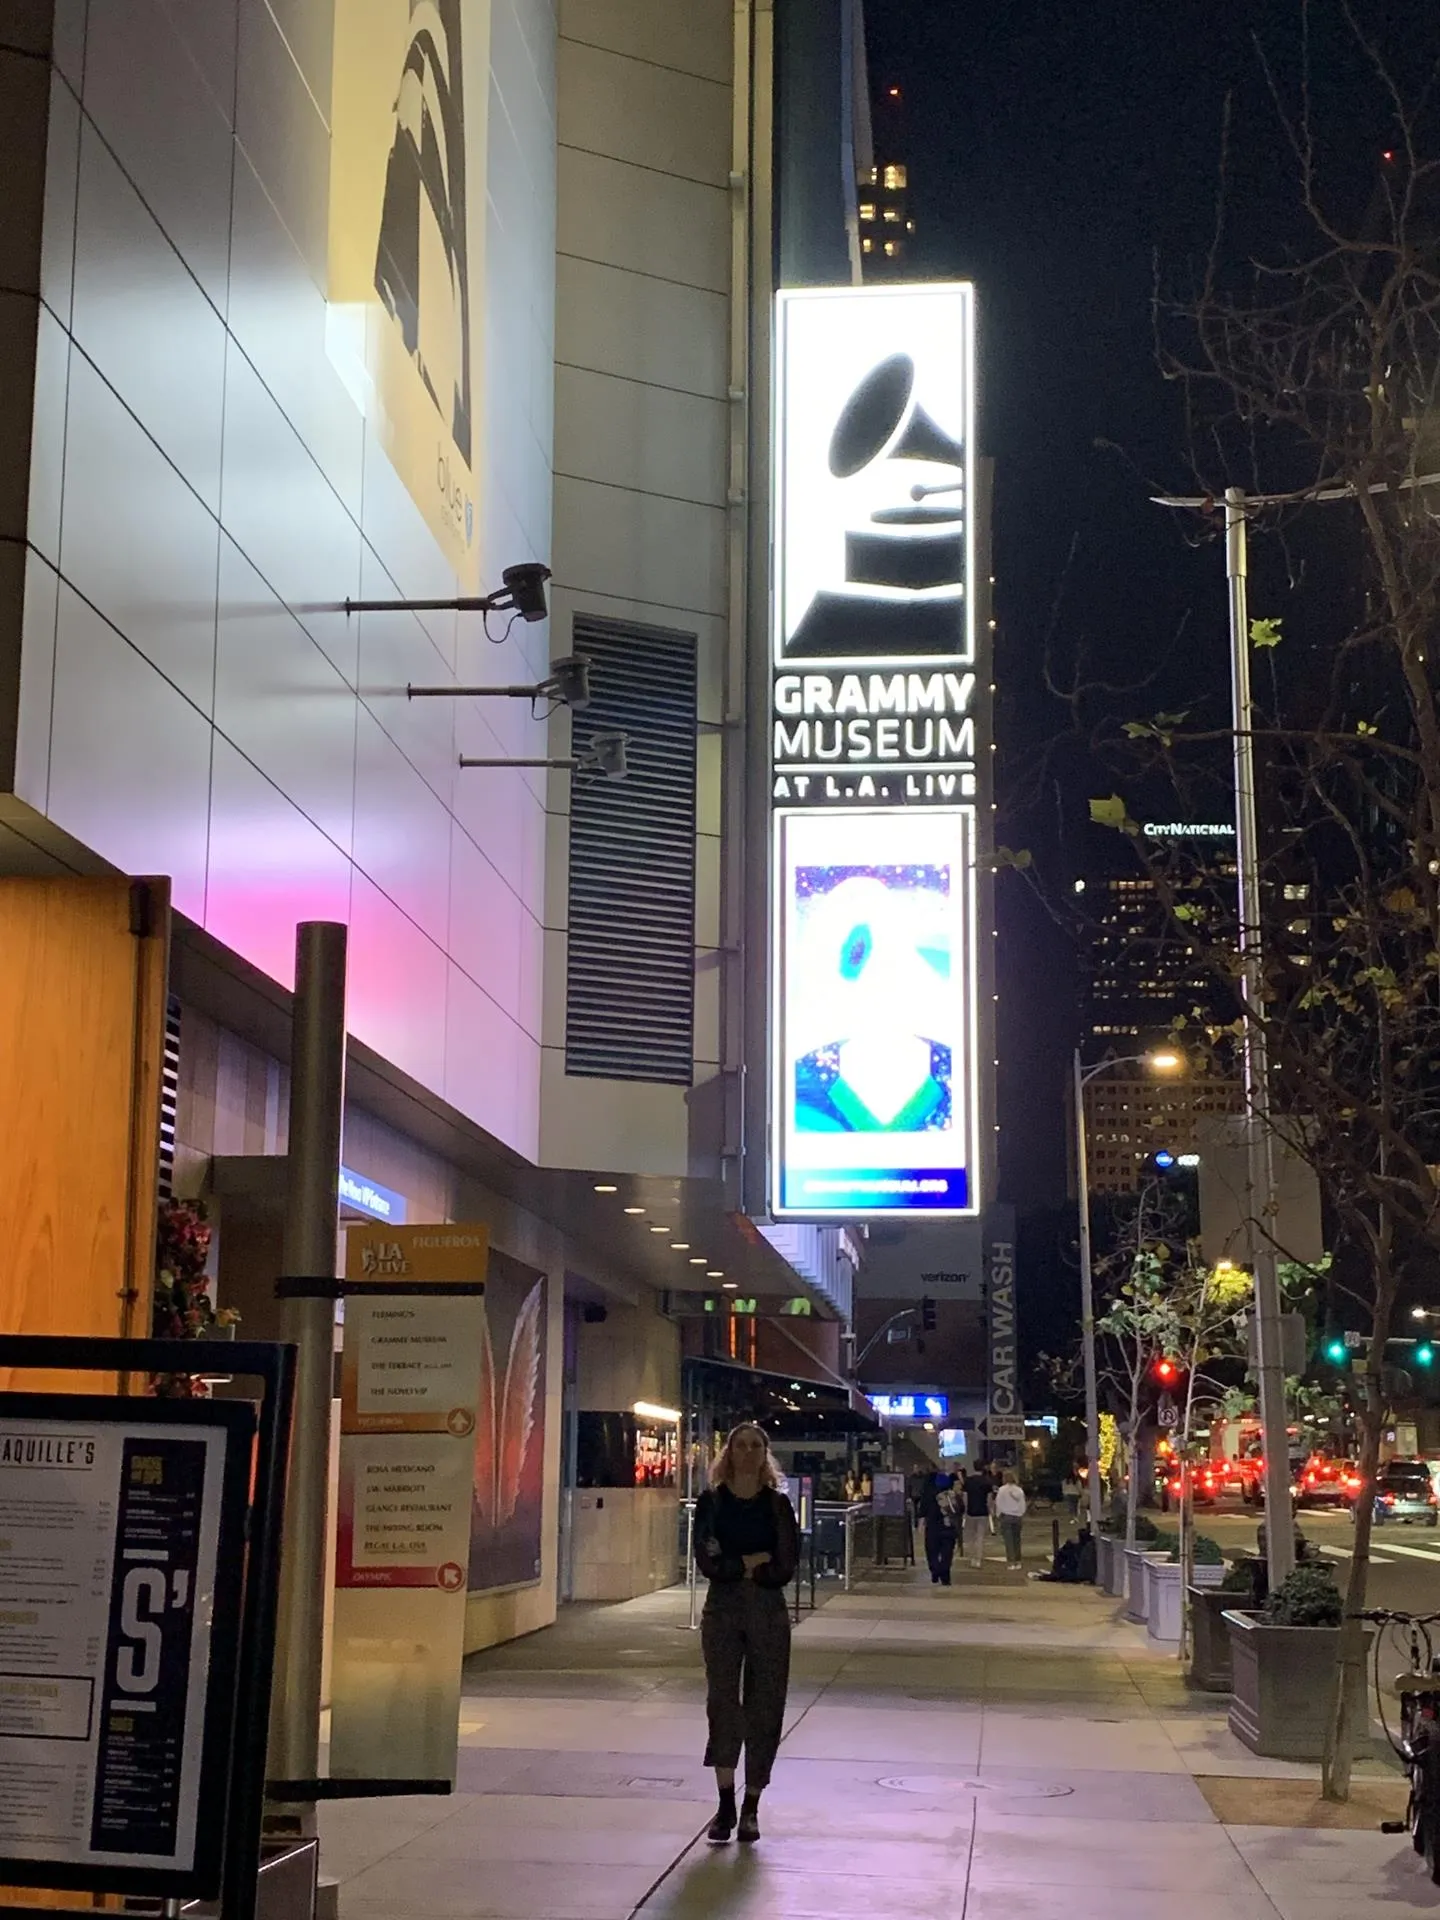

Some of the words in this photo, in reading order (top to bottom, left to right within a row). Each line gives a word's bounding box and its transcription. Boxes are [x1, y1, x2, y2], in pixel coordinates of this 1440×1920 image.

[774, 673, 976, 714] GRAMMY
[774, 718, 975, 759] MUSEUM
[773, 776, 810, 797] AT
[826, 775, 889, 797] L.A.
[906, 774, 976, 796] LIVE
[412, 1235, 480, 1249] FIGUEROA
[378, 1260, 411, 1273] LIVE
[920, 1270, 967, 1283] verizon
[991, 1242, 1014, 1339] WASH
[991, 1346, 1014, 1414] CAR
[992, 1425, 1022, 1436] OPEN
